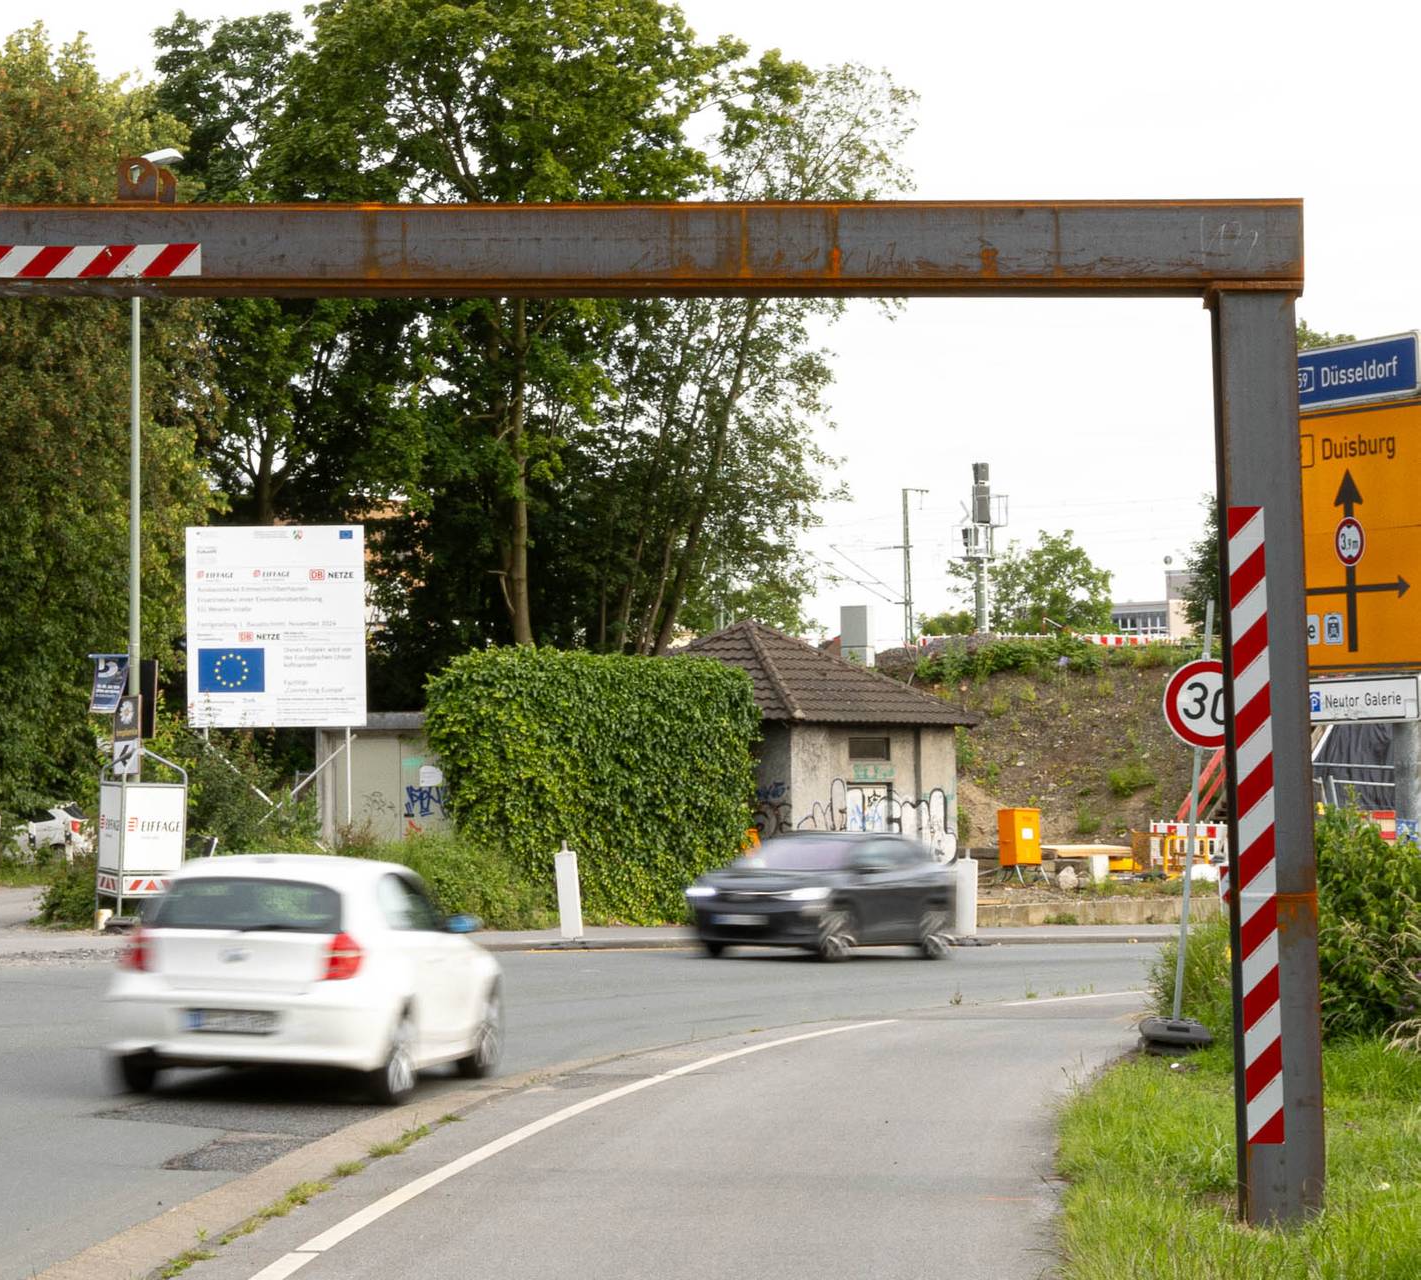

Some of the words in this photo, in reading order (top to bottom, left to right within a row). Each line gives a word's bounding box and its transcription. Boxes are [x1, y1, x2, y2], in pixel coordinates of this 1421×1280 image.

[1320, 355, 1398, 388] Düsseldorf
[1321, 434, 1396, 461] Duisburg
[311, 571, 324, 579] DB
[328, 571, 354, 579] NETZE
[256, 633, 281, 641] NETZE
[1325, 695, 1359, 708] Neutor
[1364, 690, 1401, 706] Galerie
[141, 820, 181, 832] EIFFAGE
